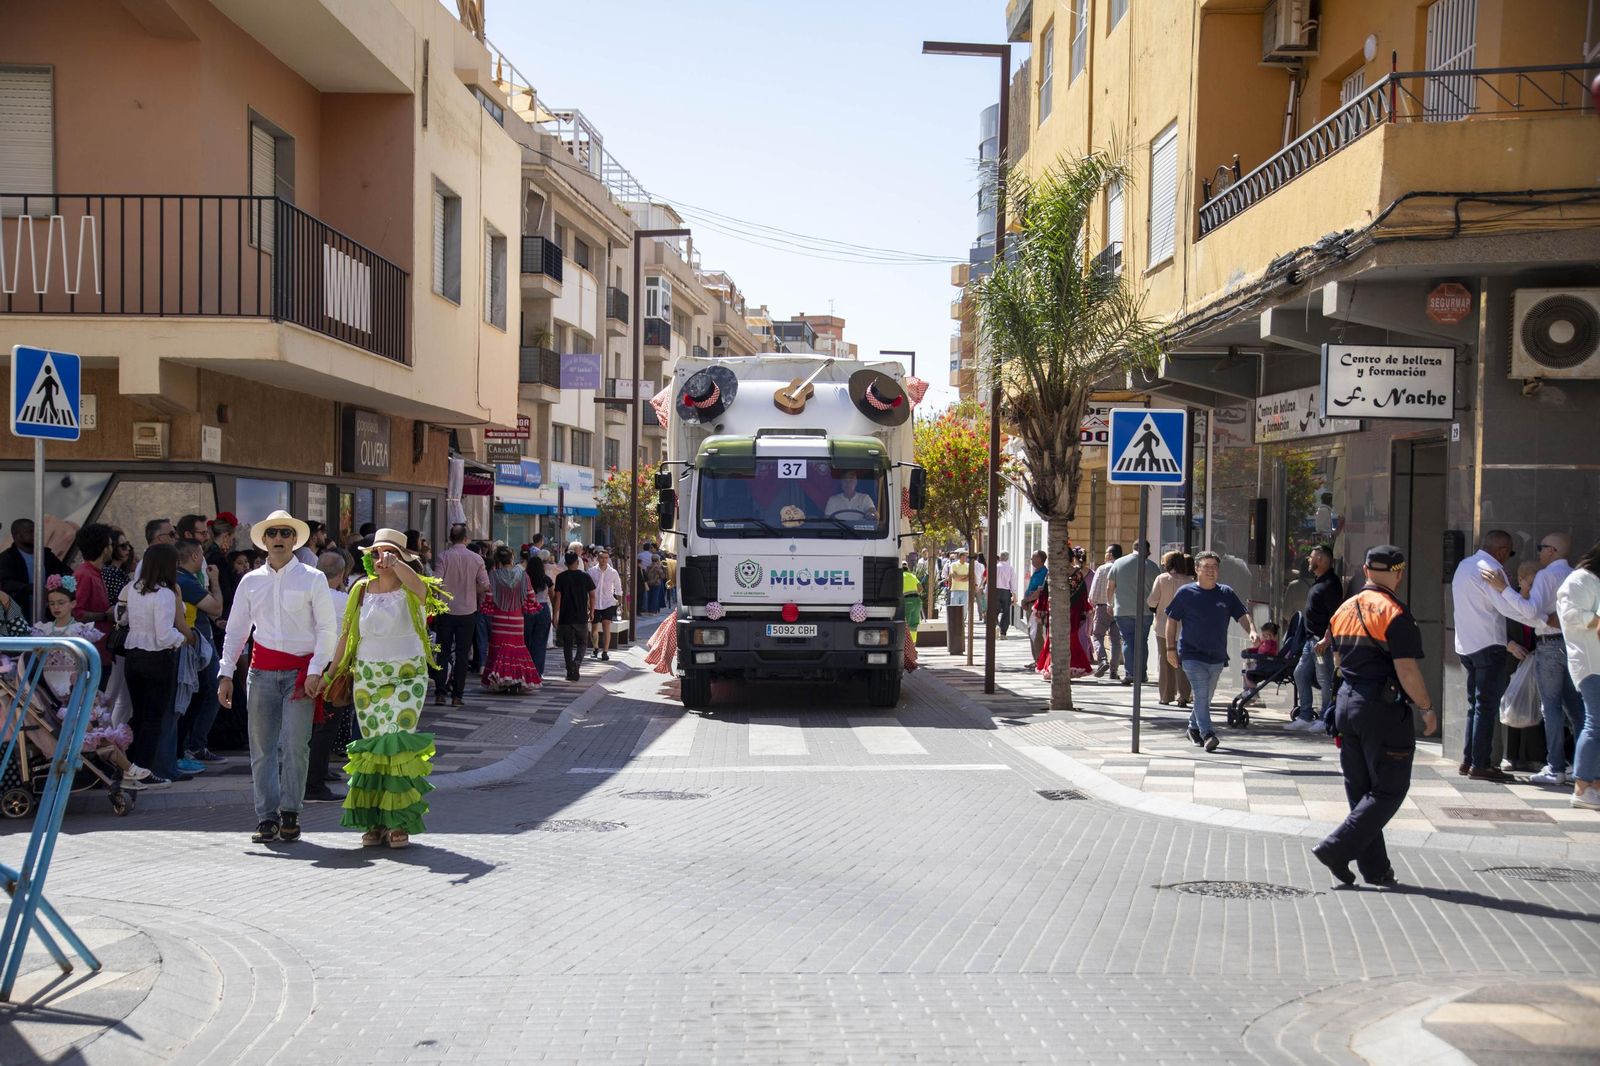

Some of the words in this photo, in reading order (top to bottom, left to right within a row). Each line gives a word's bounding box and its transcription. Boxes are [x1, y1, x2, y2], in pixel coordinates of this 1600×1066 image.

[1340, 353, 1381, 366] Centro
[1385, 355, 1399, 364] de
[1402, 355, 1442, 366] belleza
[1357, 368, 1364, 378] y
[1369, 366, 1427, 377] formación
[1373, 387, 1447, 408] Nache
[360, 440, 389, 468] OLVERA
[782, 463, 802, 476] 37
[770, 568, 855, 586] MIGUEL
[773, 626, 795, 635] 5092
[798, 626, 816, 635] CBH
